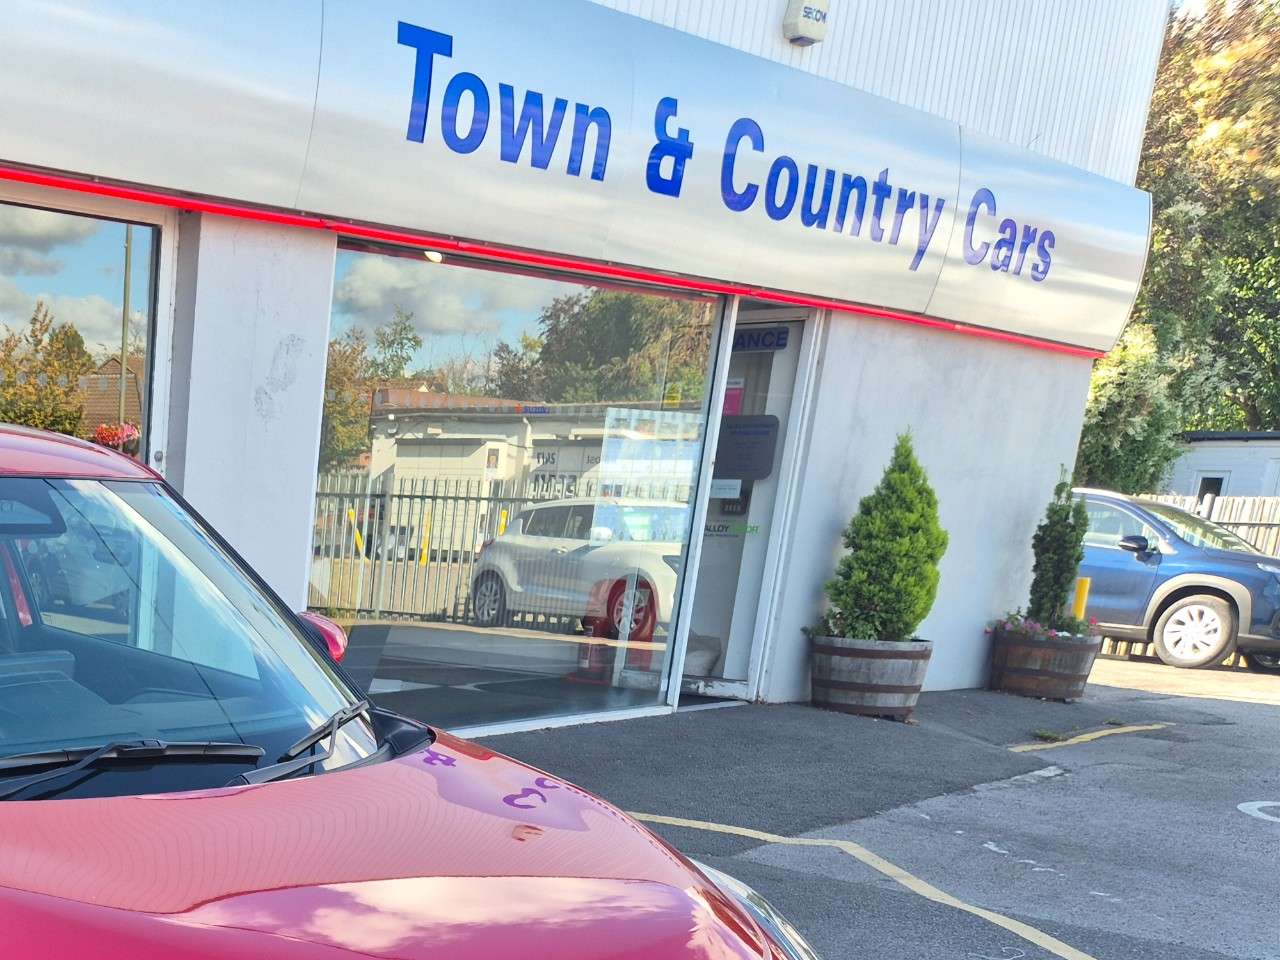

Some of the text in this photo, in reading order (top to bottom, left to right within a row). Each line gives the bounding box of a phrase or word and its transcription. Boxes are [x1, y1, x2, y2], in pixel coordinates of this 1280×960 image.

[398, 21, 1056, 282] Town & Country Cars
[735, 330, 789, 349] ANCE
